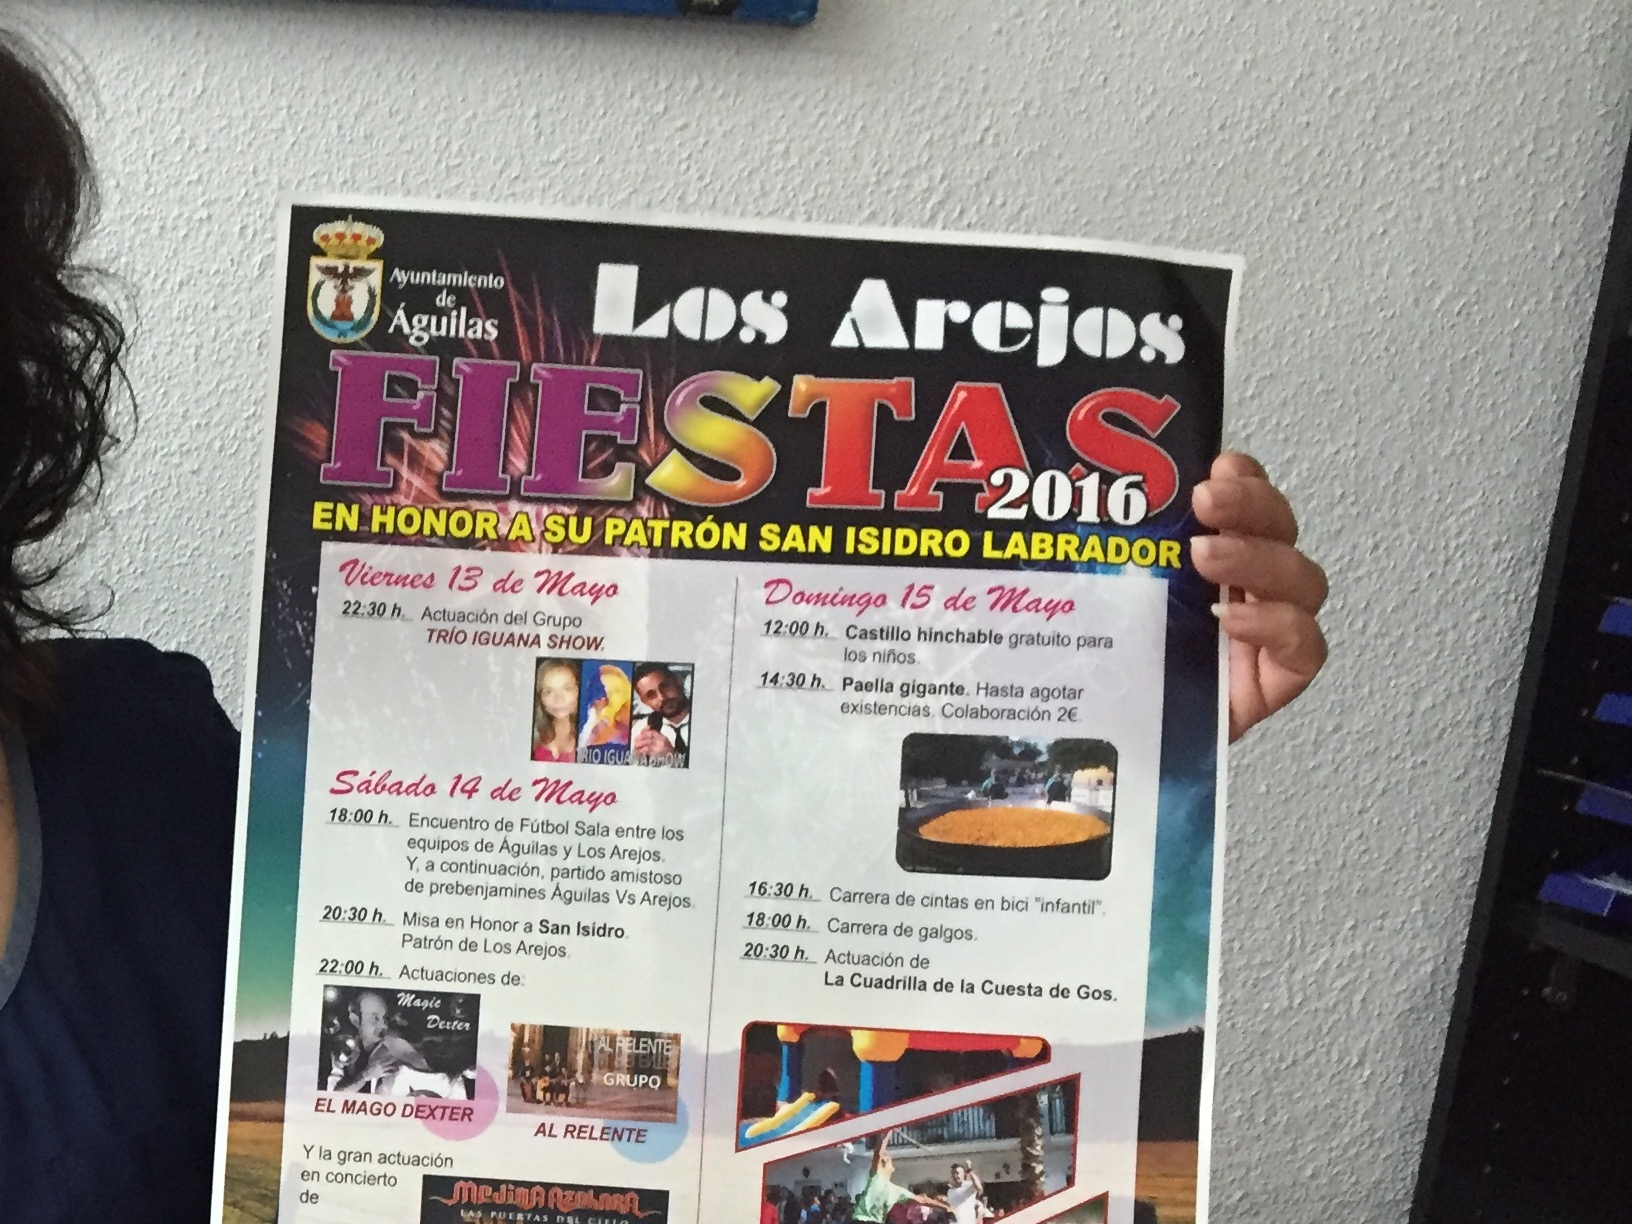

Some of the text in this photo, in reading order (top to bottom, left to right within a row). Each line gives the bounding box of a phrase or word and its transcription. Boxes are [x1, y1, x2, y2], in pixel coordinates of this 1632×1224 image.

[389, 267, 505, 291] Ayuntamiento
[436, 291, 456, 307] de
[388, 302, 499, 346] Águilas
[592, 262, 1186, 368] Los Arejos
[320, 348, 1181, 516] FIESTAS
[986, 468, 1148, 526] 2016
[312, 501, 1182, 569] EN HONOR A SU PATRÓN SAN ISIDRO LABRADOR
[338, 558, 620, 606] Viernes 13 de Mayo
[762, 577, 1075, 621] Domingo 15 de Mayo
[342, 600, 582, 630] 22:30 h. Actuación del Grupo
[426, 627, 467, 645] TRÍO
[472, 631, 541, 649] IGUANA
[763, 619, 1114, 650] 12:00 h. Castillo hinchable gratuito para
[329, 769, 618, 813] Sábado 14 de Mayo
[329, 807, 684, 842] 18:00 h. Encuentro de Fútbol Sala entre los
[322, 905, 369, 923] 20:30
[372, 908, 387, 925] h.
[402, 912, 440, 929] Misa
[445, 916, 464, 930] en
[470, 914, 518, 933] Honor
[523, 920, 533, 933] a
[538, 919, 571, 935] San
[318, 958, 365, 976] 22:00
[368, 960, 383, 977] h.
[398, 964, 496, 985] Actuaciones
[397, 992, 442, 1009] Magic
[824, 972, 1118, 1002] La Cuadrilla de la Cuesta de Gos.
[426, 1015, 471, 1032] Dexter
[603, 1072, 661, 1090] GRUPO
[314, 1098, 474, 1122] EL MAGO DEXTER
[534, 1122, 648, 1144] AL RELENTE
